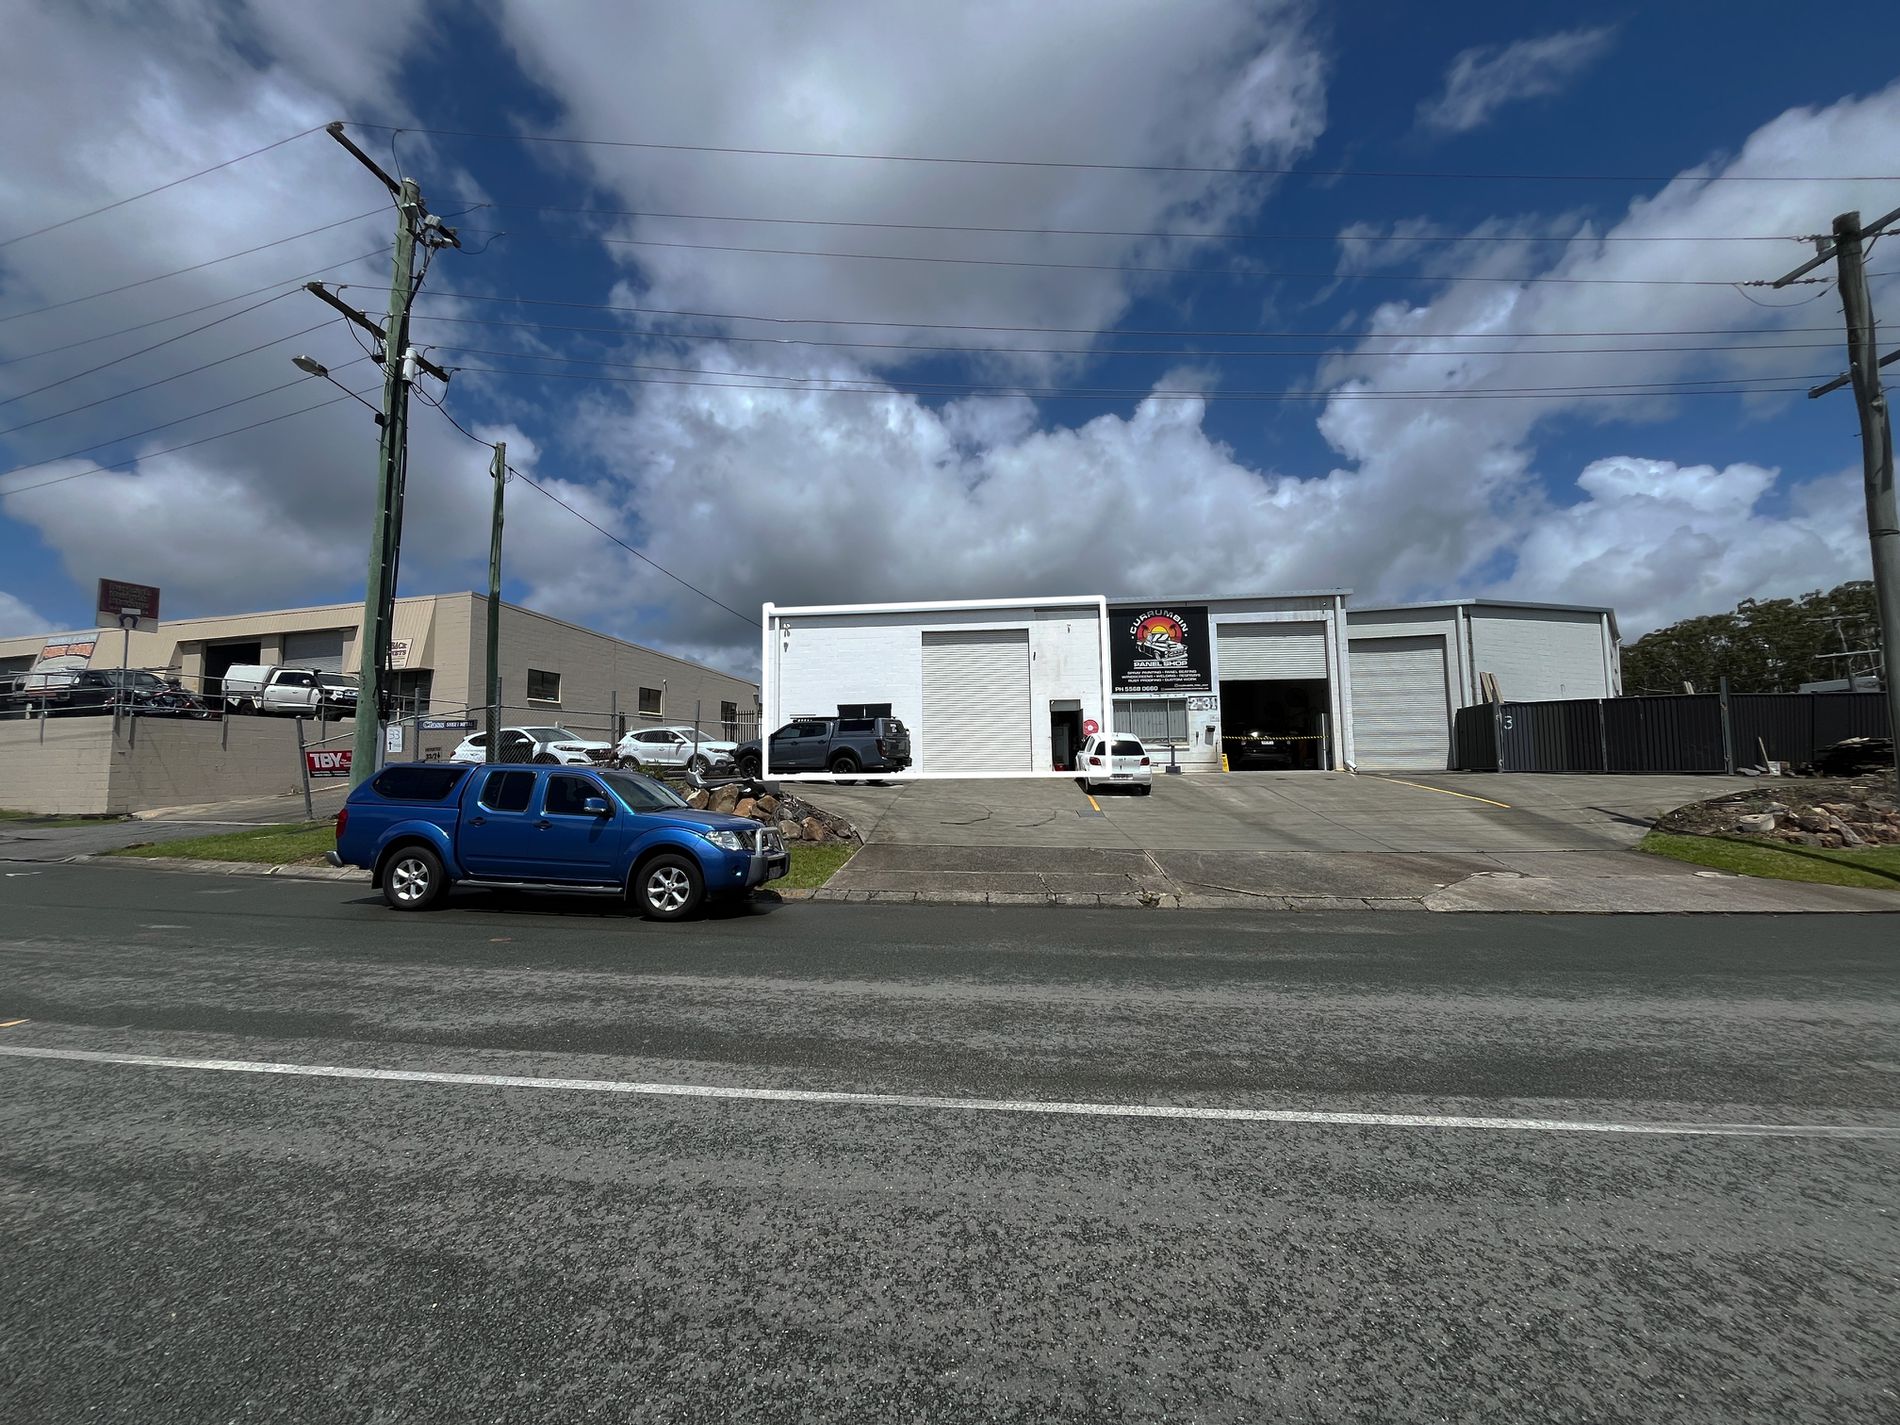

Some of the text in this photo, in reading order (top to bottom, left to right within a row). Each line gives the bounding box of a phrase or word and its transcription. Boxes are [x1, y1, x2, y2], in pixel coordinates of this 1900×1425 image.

[1130, 609, 1188, 634] CURRUMBIN
[1504, 715, 1513, 730] 3
[309, 752, 343, 768] TBY
